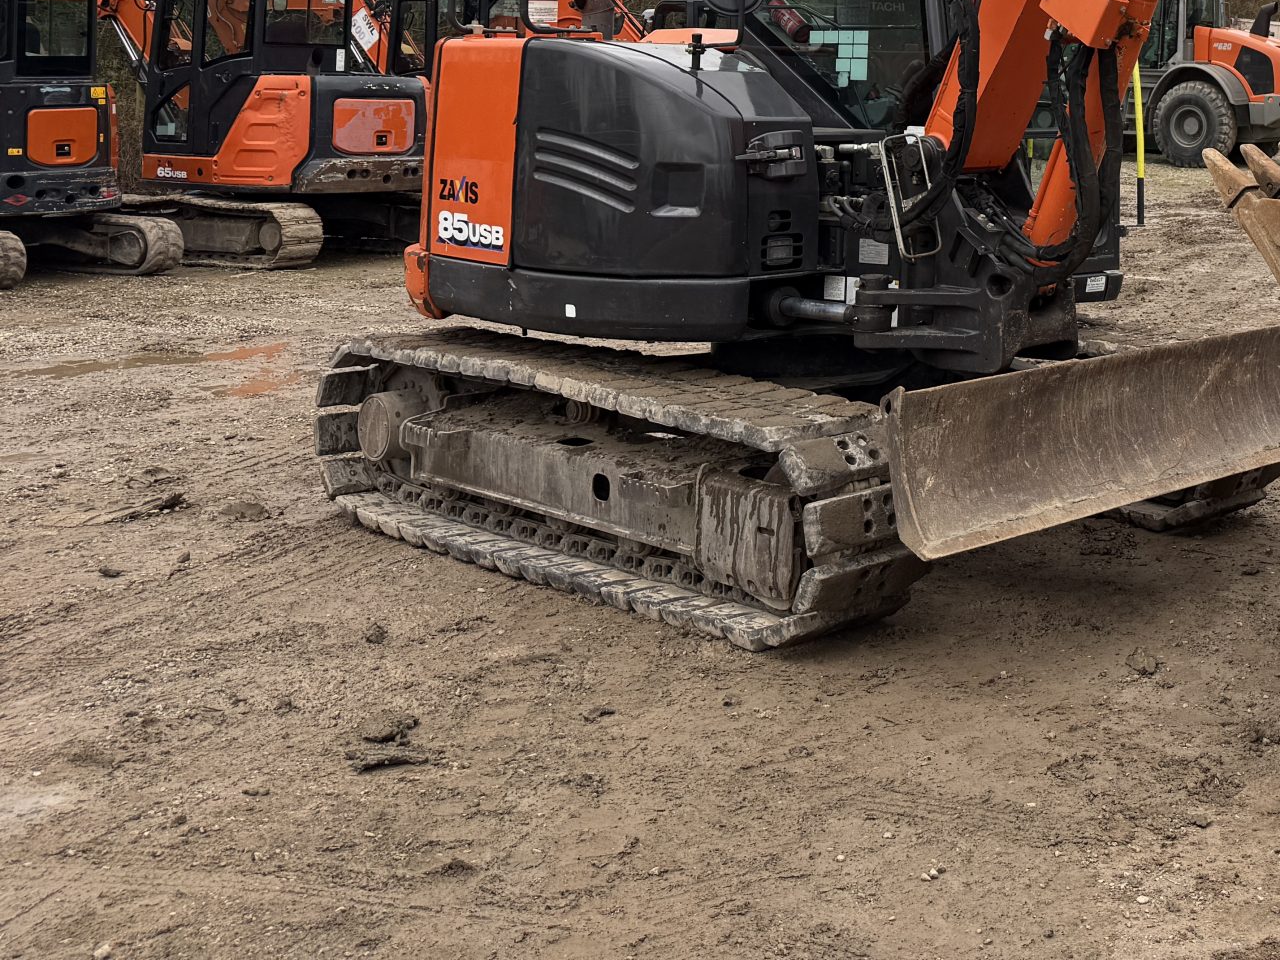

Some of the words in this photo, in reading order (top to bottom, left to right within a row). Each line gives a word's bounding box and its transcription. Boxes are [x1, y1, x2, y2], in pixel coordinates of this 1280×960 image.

[861, 0, 905, 12] TACHI
[362, 14, 375, 36] SWL
[157, 167, 188, 178] 65USB
[439, 176, 479, 204] ZAXIS
[438, 210, 504, 247] 85USB
